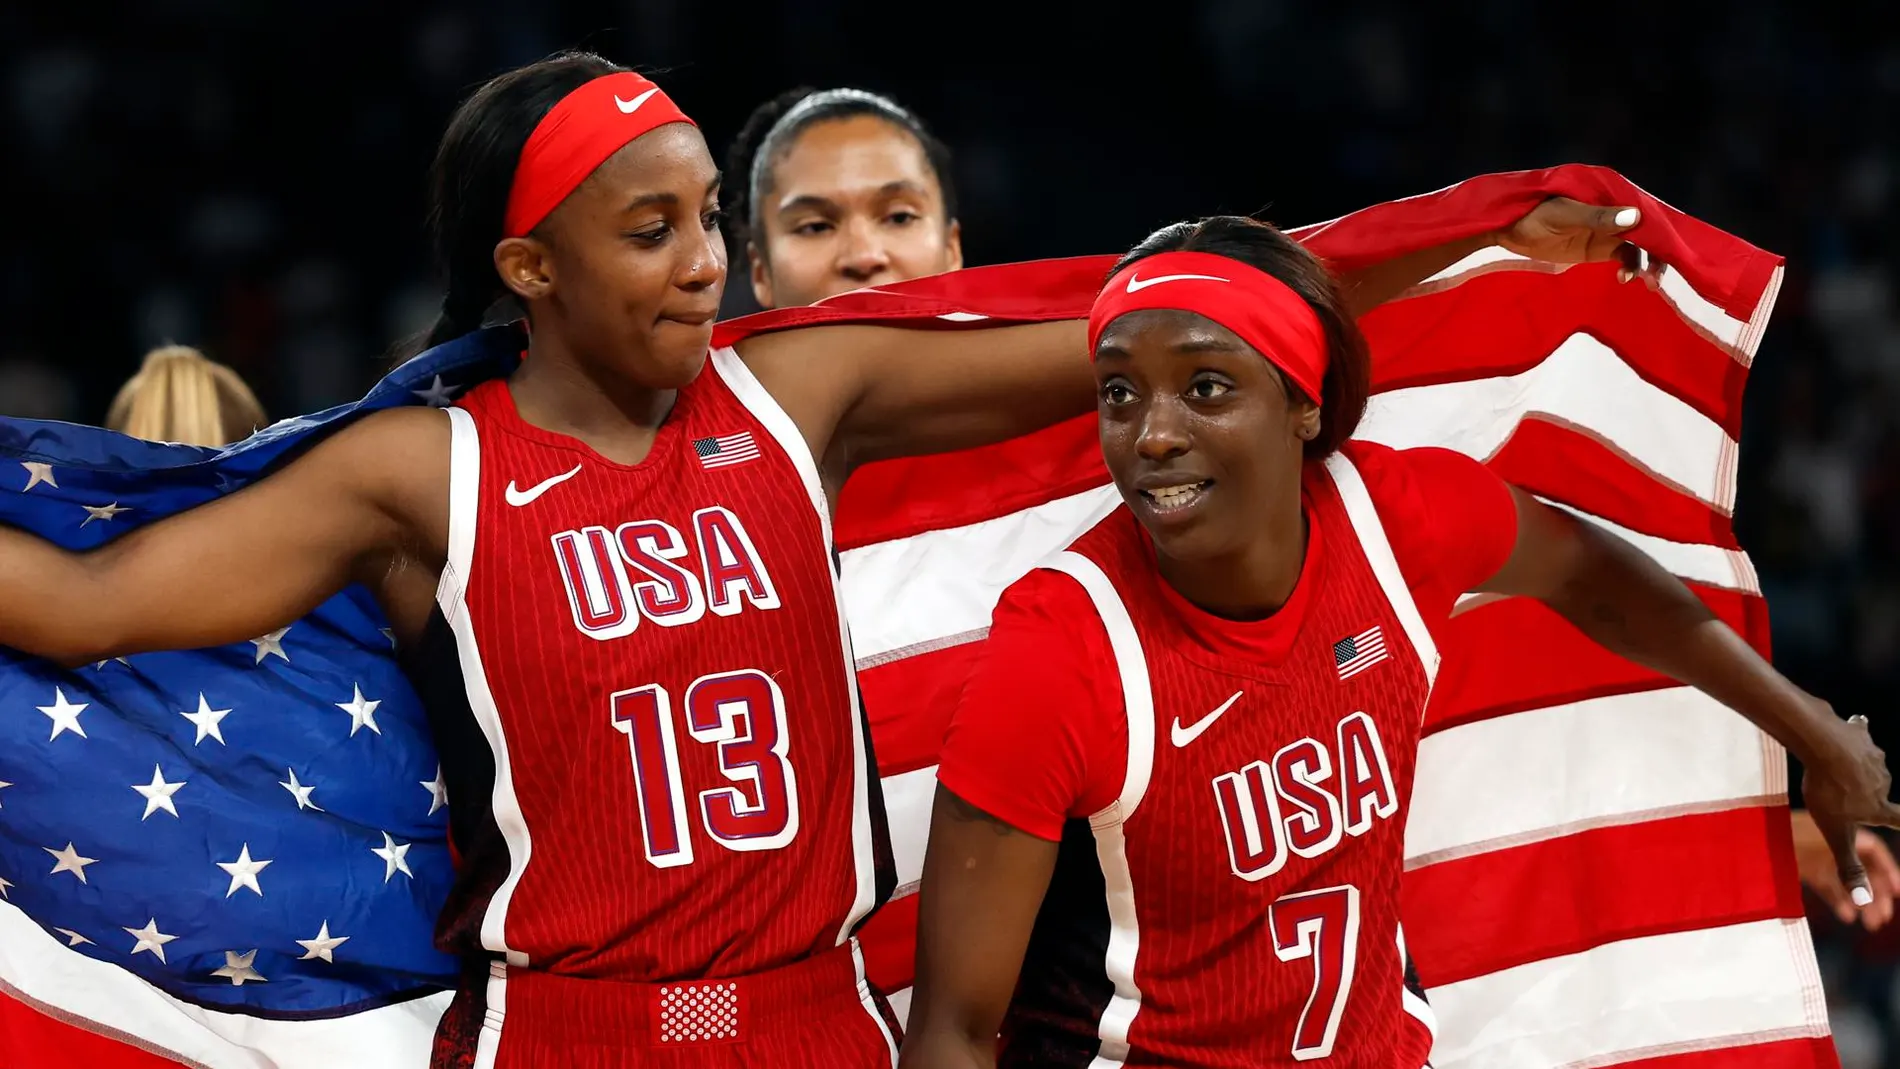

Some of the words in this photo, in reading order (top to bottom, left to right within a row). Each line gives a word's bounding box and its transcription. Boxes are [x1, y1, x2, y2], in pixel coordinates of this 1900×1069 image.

[551, 505, 781, 640] USA
[610, 668, 799, 868] 13
[1212, 711, 1398, 881] USA
[1268, 884, 1360, 1061] 7
